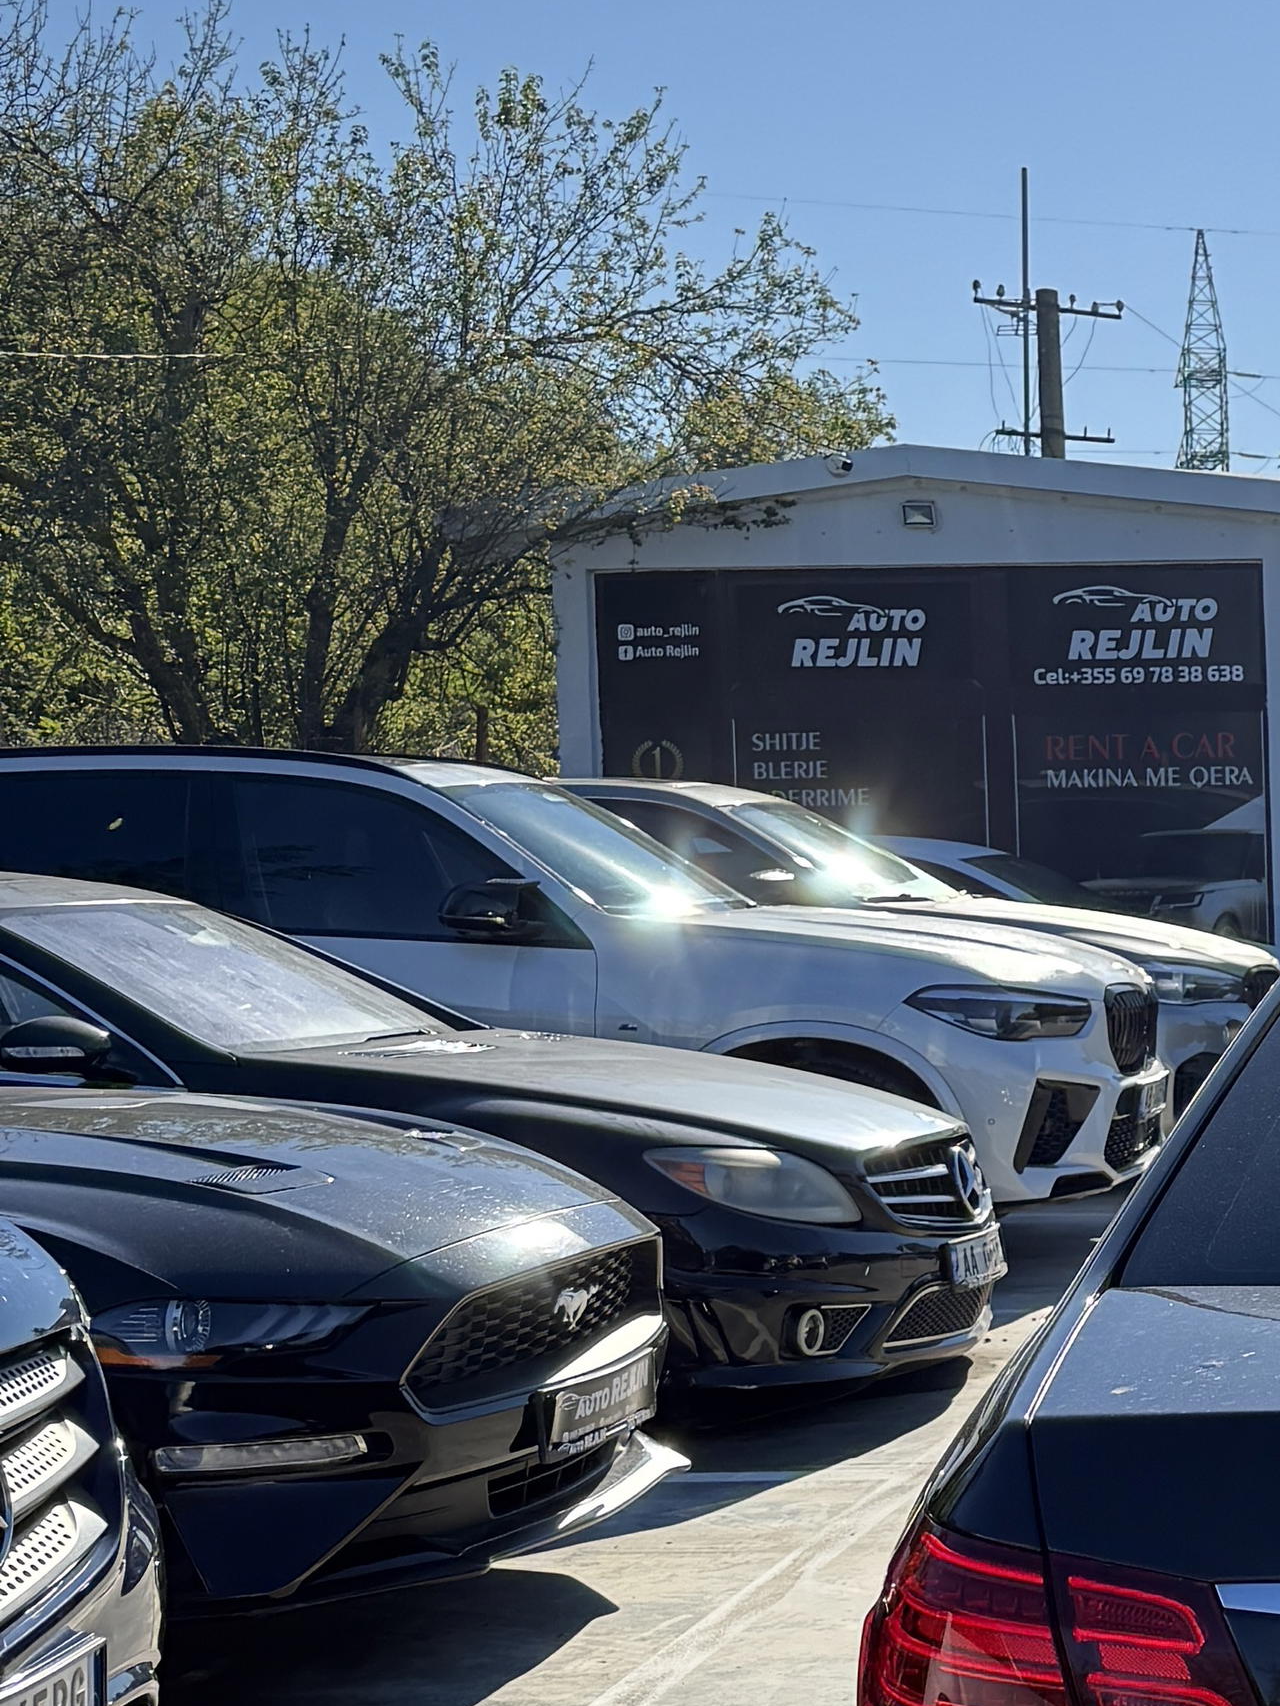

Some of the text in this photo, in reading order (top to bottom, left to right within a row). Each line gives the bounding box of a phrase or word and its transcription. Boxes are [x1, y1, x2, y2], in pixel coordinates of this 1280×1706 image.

[847, 609, 926, 632] AUTO
[1130, 598, 1218, 622] AUTO
[636, 624, 700, 639] auto_rejlin
[636, 645, 700, 660] Auto Rejlin
[791, 637, 922, 668] REJLIN
[1067, 627, 1214, 660] REJLIN
[1034, 665, 1244, 685] Cel:+355 69 78 38 638
[752, 732, 821, 752] SHITJE
[1046, 732, 1235, 761] RENT A CAR
[753, 760, 828, 781] BLERJE
[1047, 765, 1254, 788] MAKINA ME QERA
[770, 788, 870, 807] DERRIME
[575, 1387, 611, 1420] AUTO
